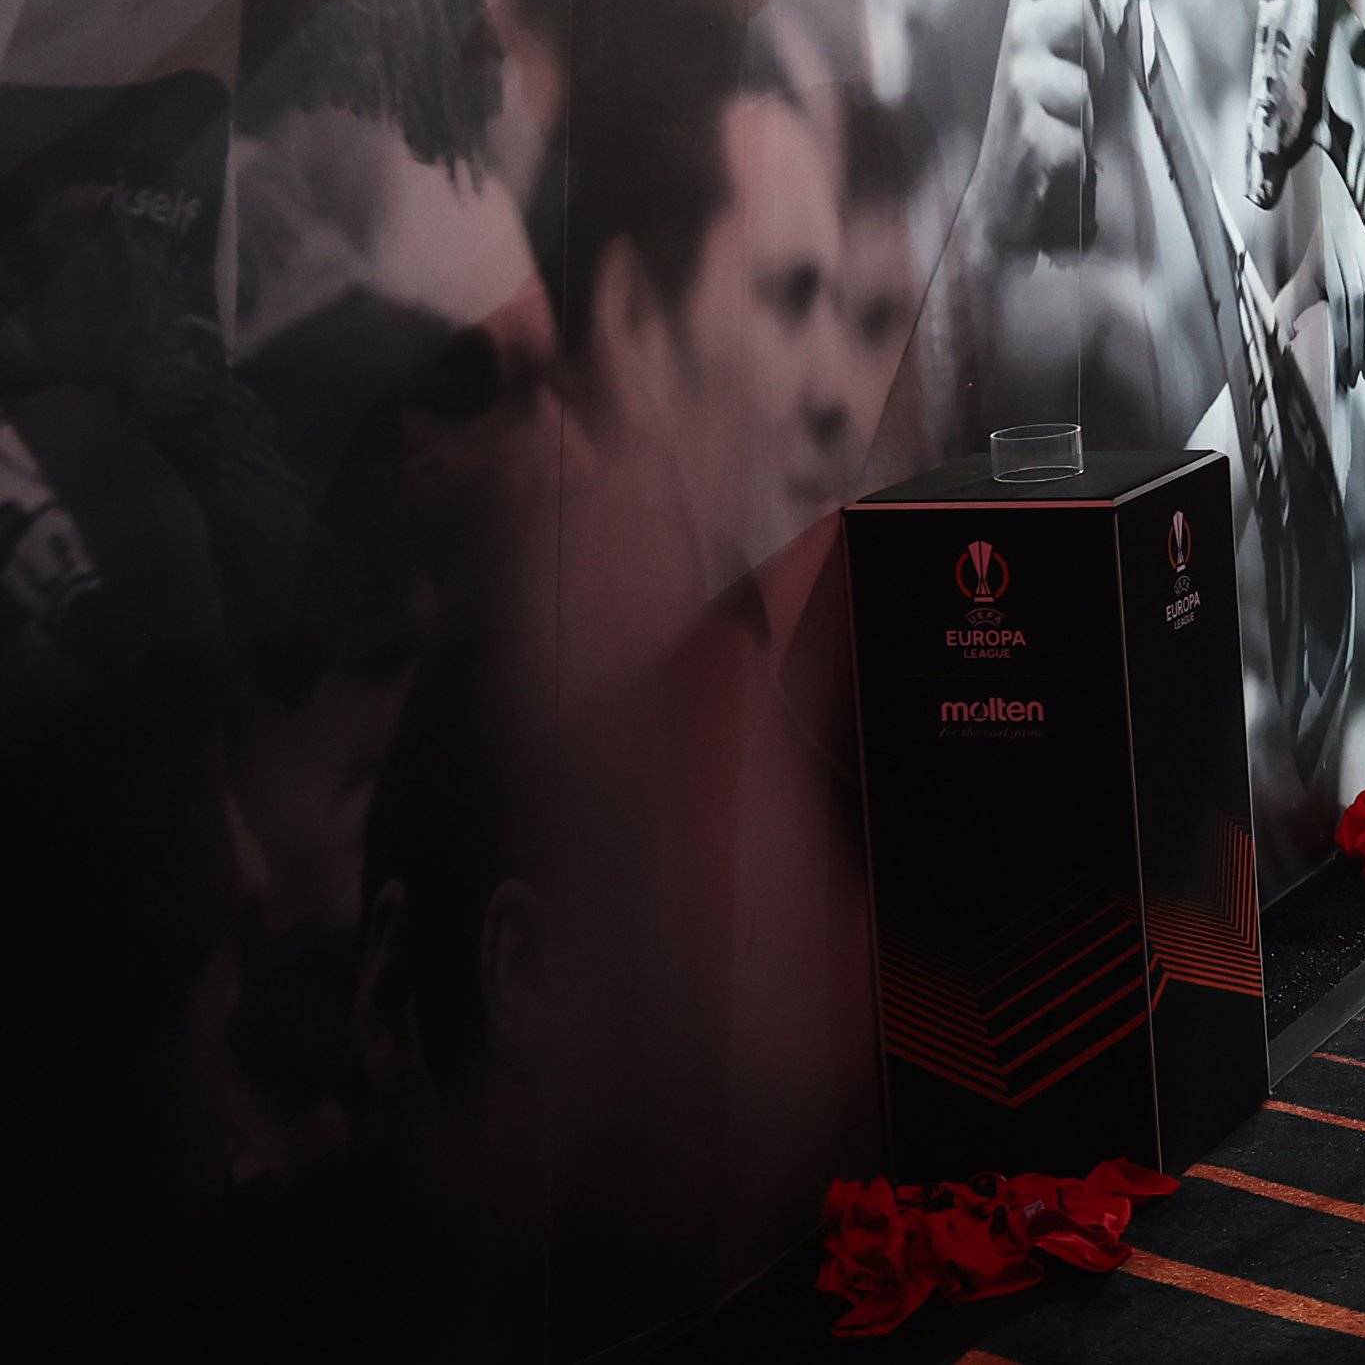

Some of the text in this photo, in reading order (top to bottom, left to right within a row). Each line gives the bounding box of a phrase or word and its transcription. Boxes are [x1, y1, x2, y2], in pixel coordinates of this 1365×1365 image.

[1166, 591, 1201, 622] EUROPA
[967, 611, 1002, 625] UEFA
[946, 630, 1027, 647] EUROPA
[963, 648, 1012, 659] LEAGUE
[941, 697, 1045, 722] molten
